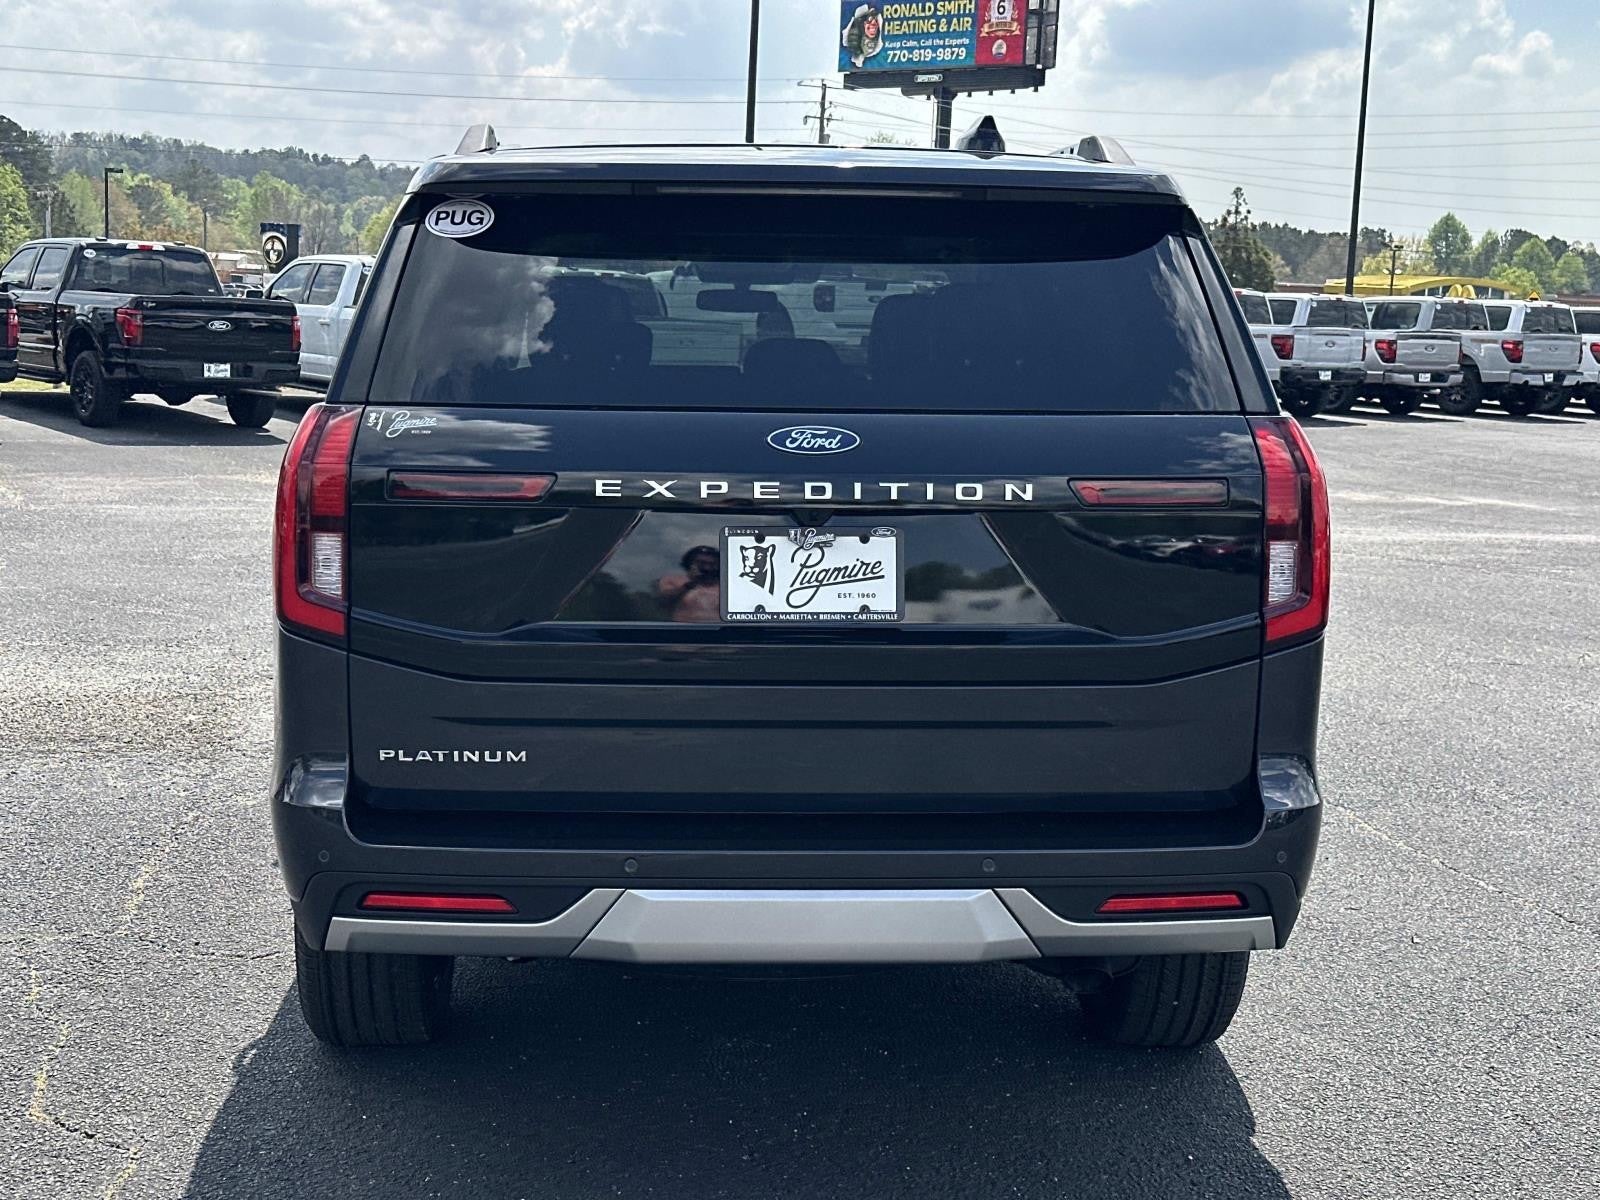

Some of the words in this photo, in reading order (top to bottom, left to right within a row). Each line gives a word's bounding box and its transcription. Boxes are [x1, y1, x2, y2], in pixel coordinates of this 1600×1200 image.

[883, 2, 935, 19] RONALD
[936, 0, 975, 16] SMITH
[996, 0, 1006, 15] 6
[884, 19, 937, 35] HEATING
[939, 18, 947, 32] &
[949, 17, 972, 31] AIR
[920, 38, 932, 46] Call
[945, 37, 970, 46] Experts
[887, 48, 966, 63] 770-819-9879
[434, 209, 485, 226] PUG
[385, 410, 438, 438] Pugmire
[785, 428, 841, 450] Ford
[594, 479, 1034, 502] EXPEDITION
[785, 545, 886, 609] Pugmire
[853, 613, 899, 621] CARTERSVILLE
[379, 749, 527, 762] PLATINUM
